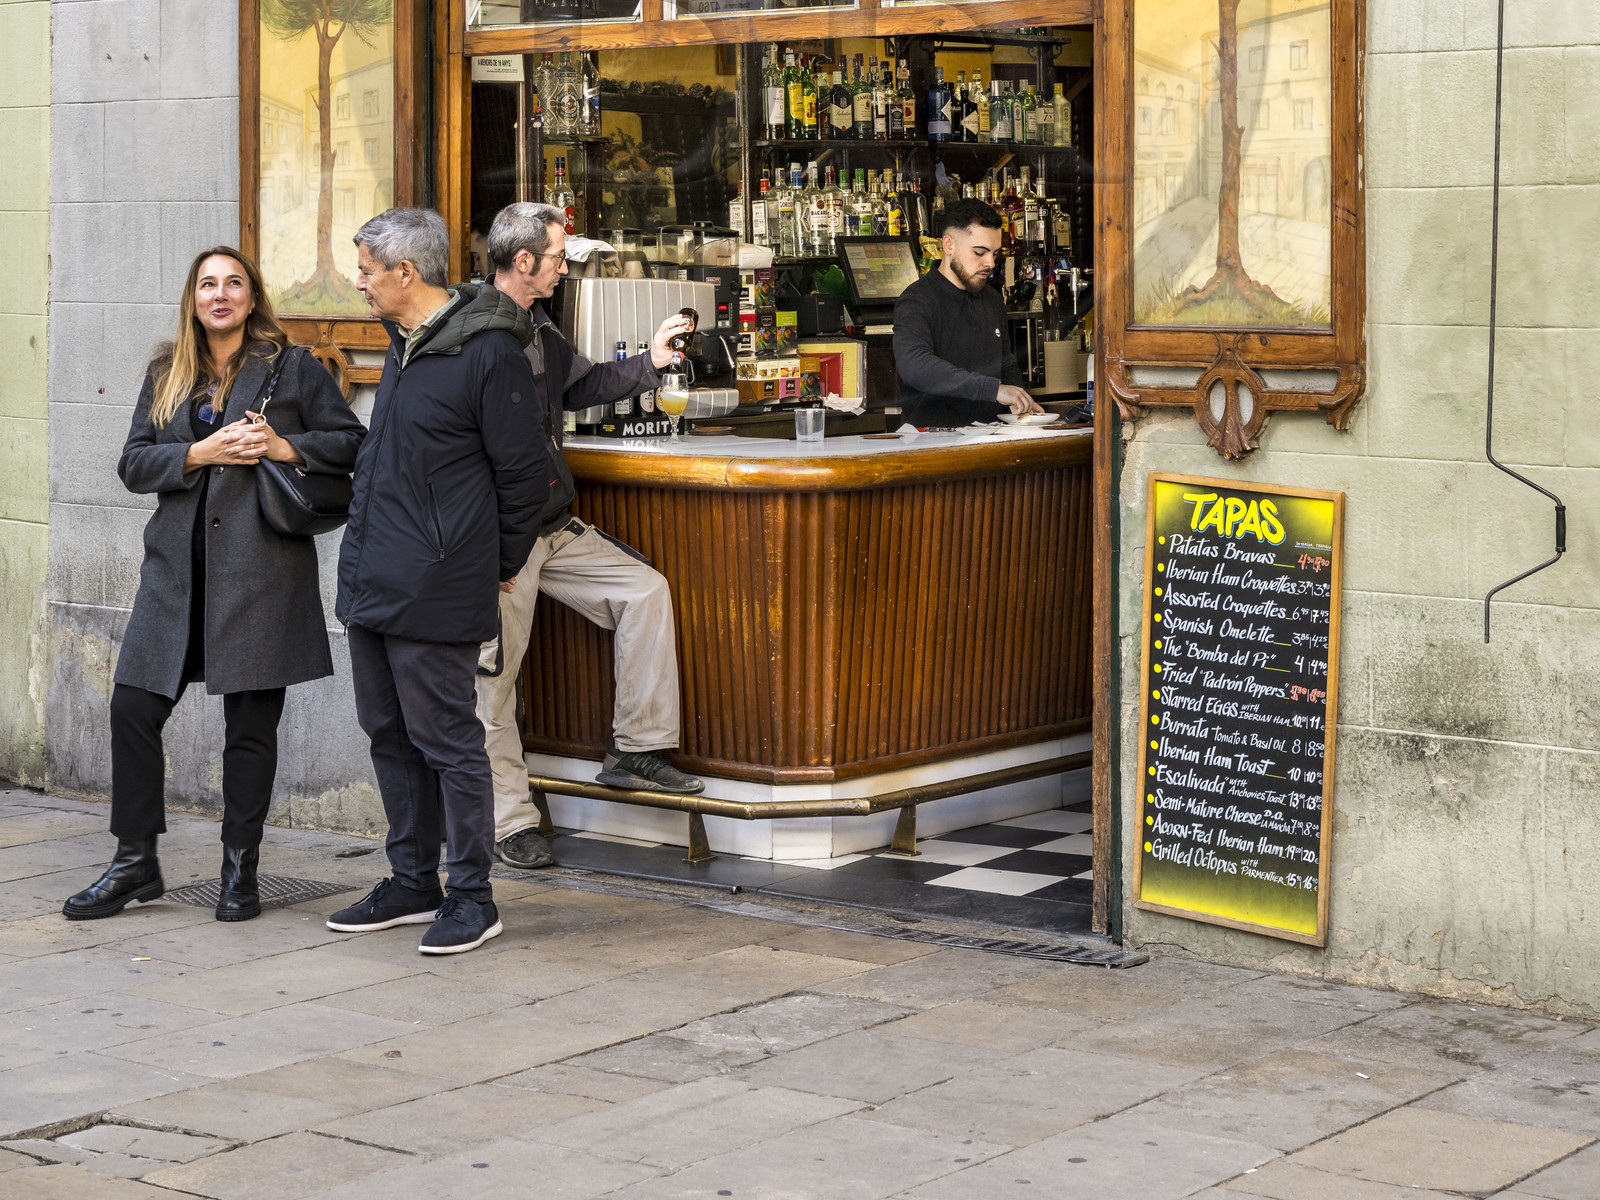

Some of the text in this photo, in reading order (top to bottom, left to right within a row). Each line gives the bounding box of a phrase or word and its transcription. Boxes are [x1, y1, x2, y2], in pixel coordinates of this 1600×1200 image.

[1183, 493, 1286, 546] TAPAS
[1170, 534, 1219, 557] Patatas
[1224, 542, 1276, 564] Bravas
[1166, 559, 1207, 584] Iberian
[1211, 563, 1240, 586] Ham
[1242, 570, 1297, 594] Croquettes
[1163, 582, 1221, 610] Assorted
[1222, 595, 1286, 618] Croquettes
[1163, 609, 1213, 635] Spanish
[1220, 618, 1274, 643] Omelette
[1163, 635, 1181, 657] The
[1230, 650, 1250, 666] del
[1294, 655, 1304, 673] 4
[1163, 661, 1198, 685] Fried
[1206, 697, 1239, 717] EGGS
[1238, 711, 1272, 722] IBERIAN
[1160, 711, 1208, 738] Burrata
[1211, 726, 1241, 744] Tomato
[1242, 735, 1247, 745] &
[1250, 733, 1273, 750] Basil
[1273, 740, 1285, 751] Oil
[1292, 739, 1301, 754] 8
[1159, 736, 1200, 764] Iberian
[1203, 746, 1232, 769] Ham
[1234, 753, 1275, 776] Toast
[1287, 768, 1301, 781] 10
[1155, 788, 1224, 819] Semi-Mature
[1225, 805, 1262, 826] Cheese
[1228, 786, 1265, 800] Anchovies
[1265, 791, 1287, 804] Toast
[1263, 810, 1284, 821] D.O.
[1152, 838, 1193, 867] Grilled
[1194, 847, 1237, 875] Octopus
[1217, 829, 1254, 852] Iberian
[1257, 837, 1283, 857] Ham
